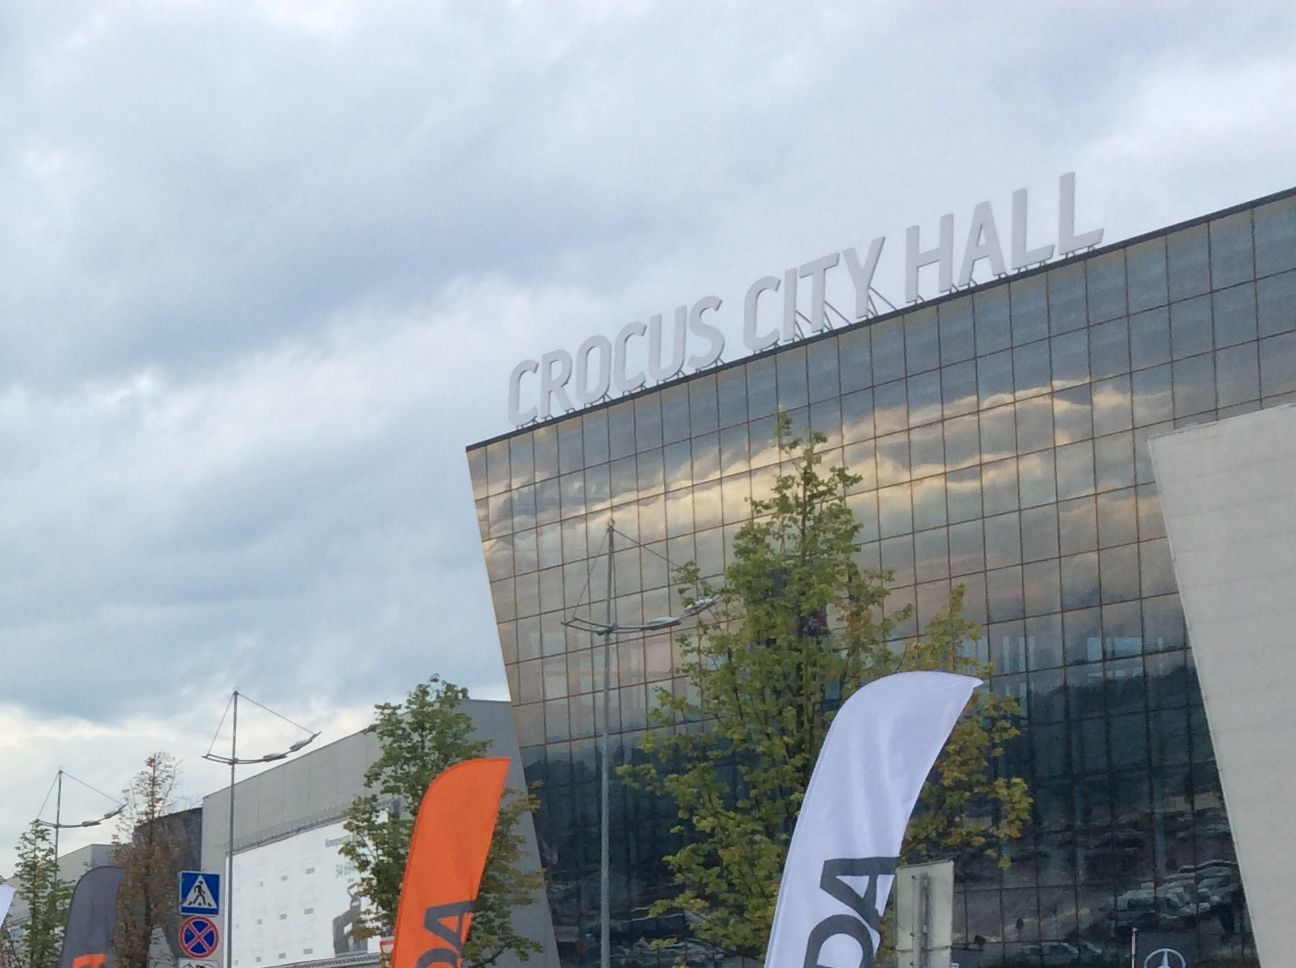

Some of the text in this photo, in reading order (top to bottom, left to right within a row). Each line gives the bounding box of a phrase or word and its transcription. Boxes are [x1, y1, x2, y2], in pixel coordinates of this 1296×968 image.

[507, 171, 1104, 426] CROCUS CITY HALL
